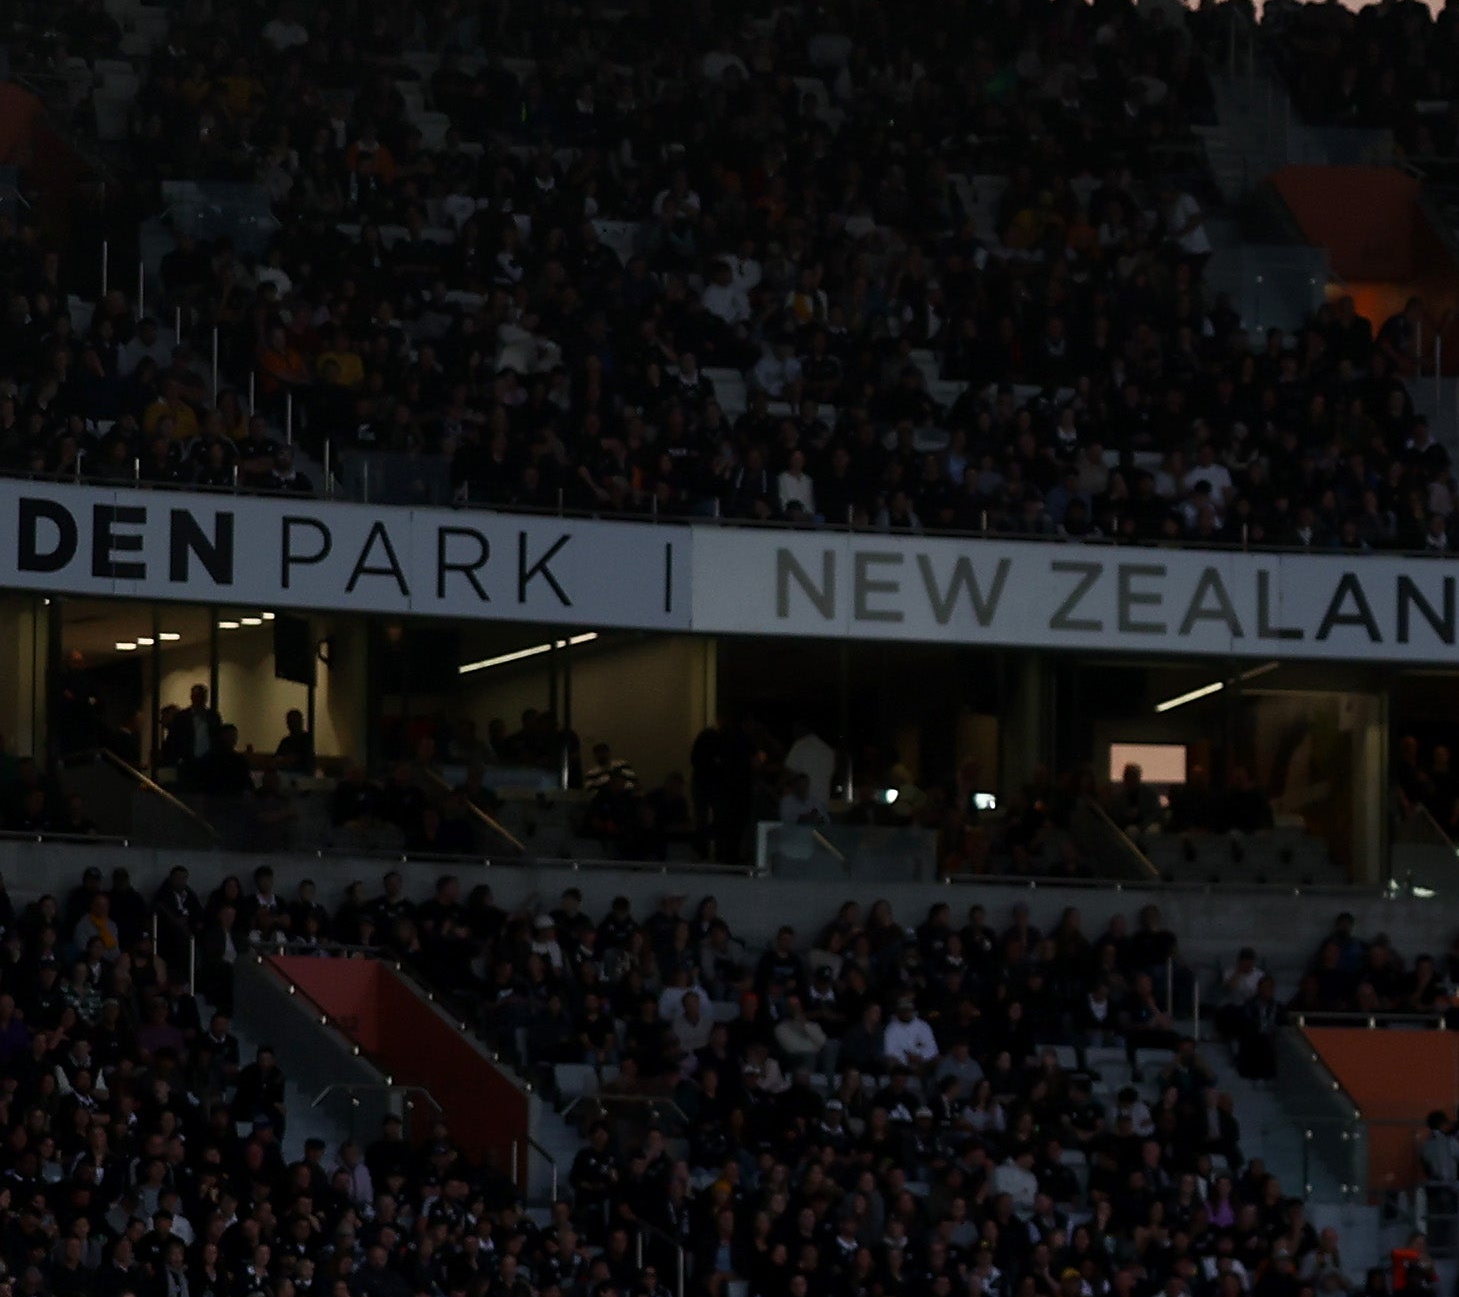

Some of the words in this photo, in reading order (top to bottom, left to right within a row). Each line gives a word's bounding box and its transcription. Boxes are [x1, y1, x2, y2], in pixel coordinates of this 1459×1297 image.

[16, 497, 234, 587] DEN
[280, 515, 573, 608] PARK
[776, 547, 1012, 628] NEW
